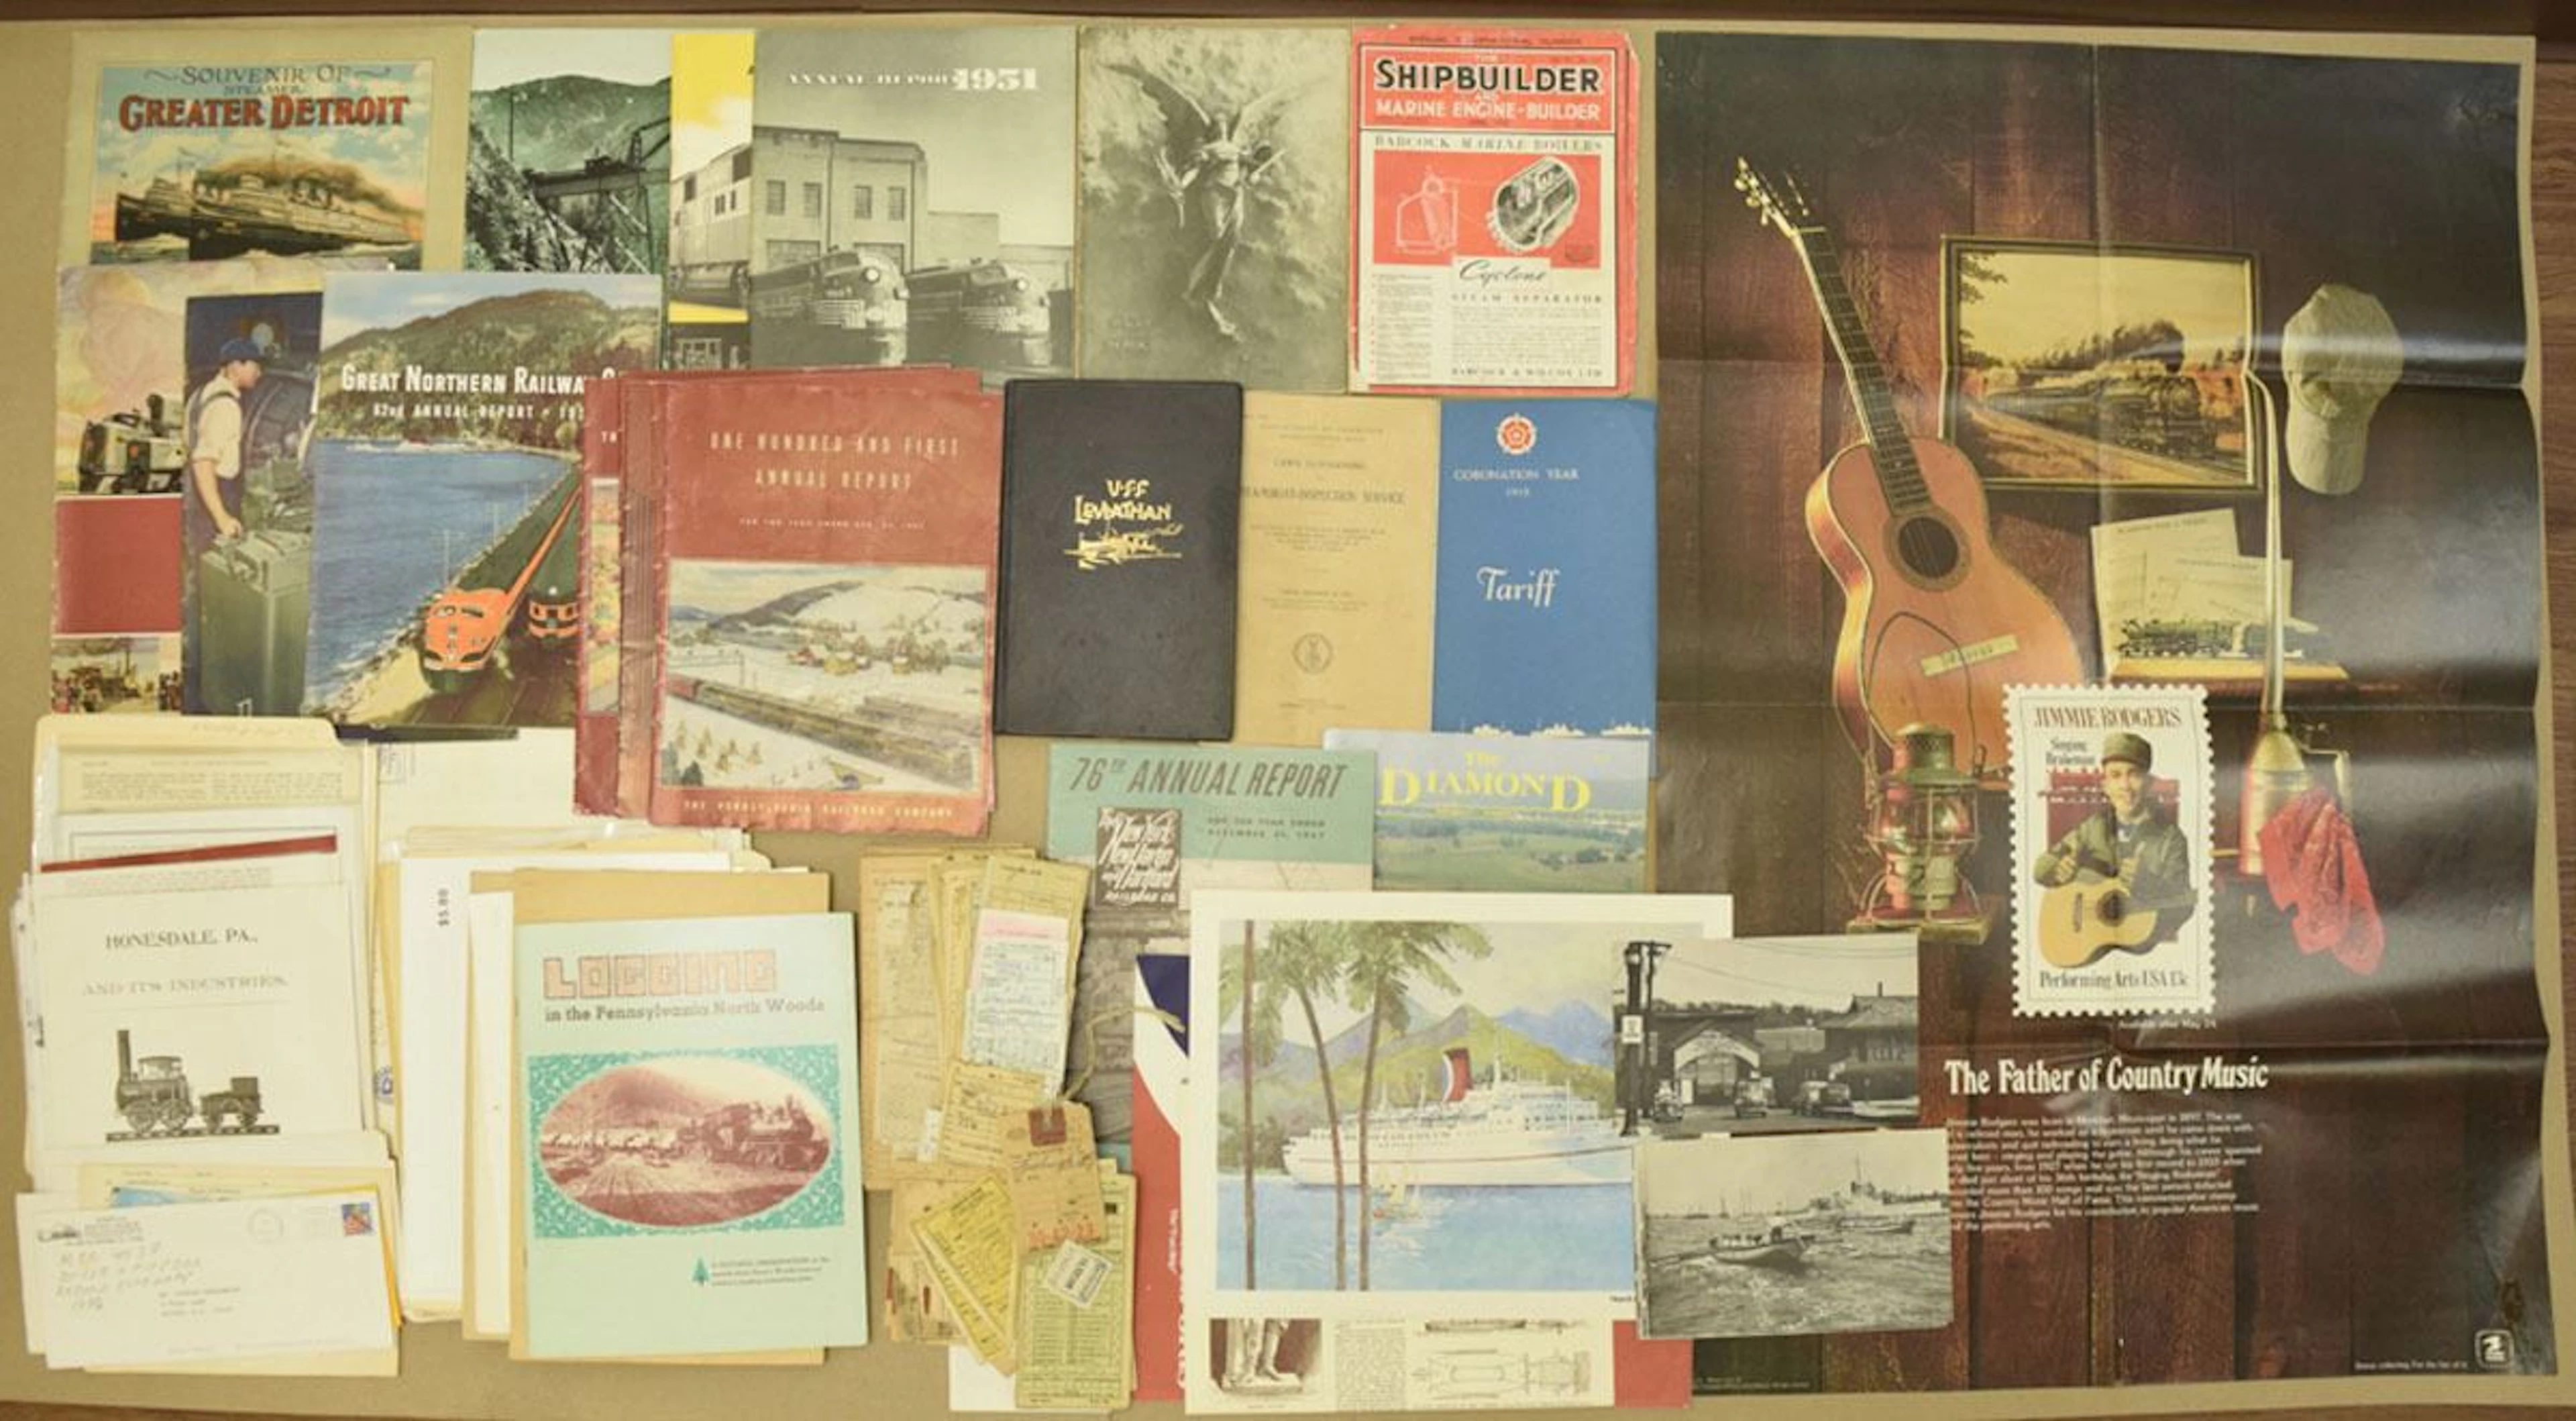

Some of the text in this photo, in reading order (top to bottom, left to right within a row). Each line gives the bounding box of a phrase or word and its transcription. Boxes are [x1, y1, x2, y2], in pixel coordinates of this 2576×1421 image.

[179, 64, 351, 85] SOUVENIR OF
[953, 66, 1040, 93] 1951
[1377, 59, 1601, 93] SHIPBUILDER
[119, 93, 411, 133] GREATER DETROIT
[1375, 99, 1601, 121] MARINE ENGINE-BUILDER
[1458, 259, 1547, 287] Cyclone
[342, 363, 402, 392] GREAT
[405, 364, 507, 394] NORTHERN
[514, 366, 589, 394] RAILWA
[412, 404, 469, 419] ANNUAL
[710, 431, 743, 450] ONE
[757, 433, 844, 453] HUNDRED
[903, 437, 960, 457] FIRST
[755, 468, 912, 491] ANNUAL REPORT
[1453, 468, 1580, 482] CORONATION YEAR
[1074, 494, 1172, 525] LEVIATHAN
[1477, 566, 1561, 608] Tariff
[2035, 706, 2182, 729] JIMMIE RODGERS
[1127, 758, 1240, 798] ANNUAL
[1244, 762, 1348, 800] REPORT
[1379, 763, 1593, 814] DIAMOND
[83, 982, 123, 997] AND
[129, 980, 162, 996] ITS
[542, 949, 777, 1000] LOGGING
[2039, 970, 2112, 990] Performing
[2115, 971, 2139, 987] Arts
[2142, 970, 2167, 987] USA
[545, 996, 826, 1024] in the Pennsylvania North Woods
[1944, 1055, 2270, 1096] The Father of Country Music
